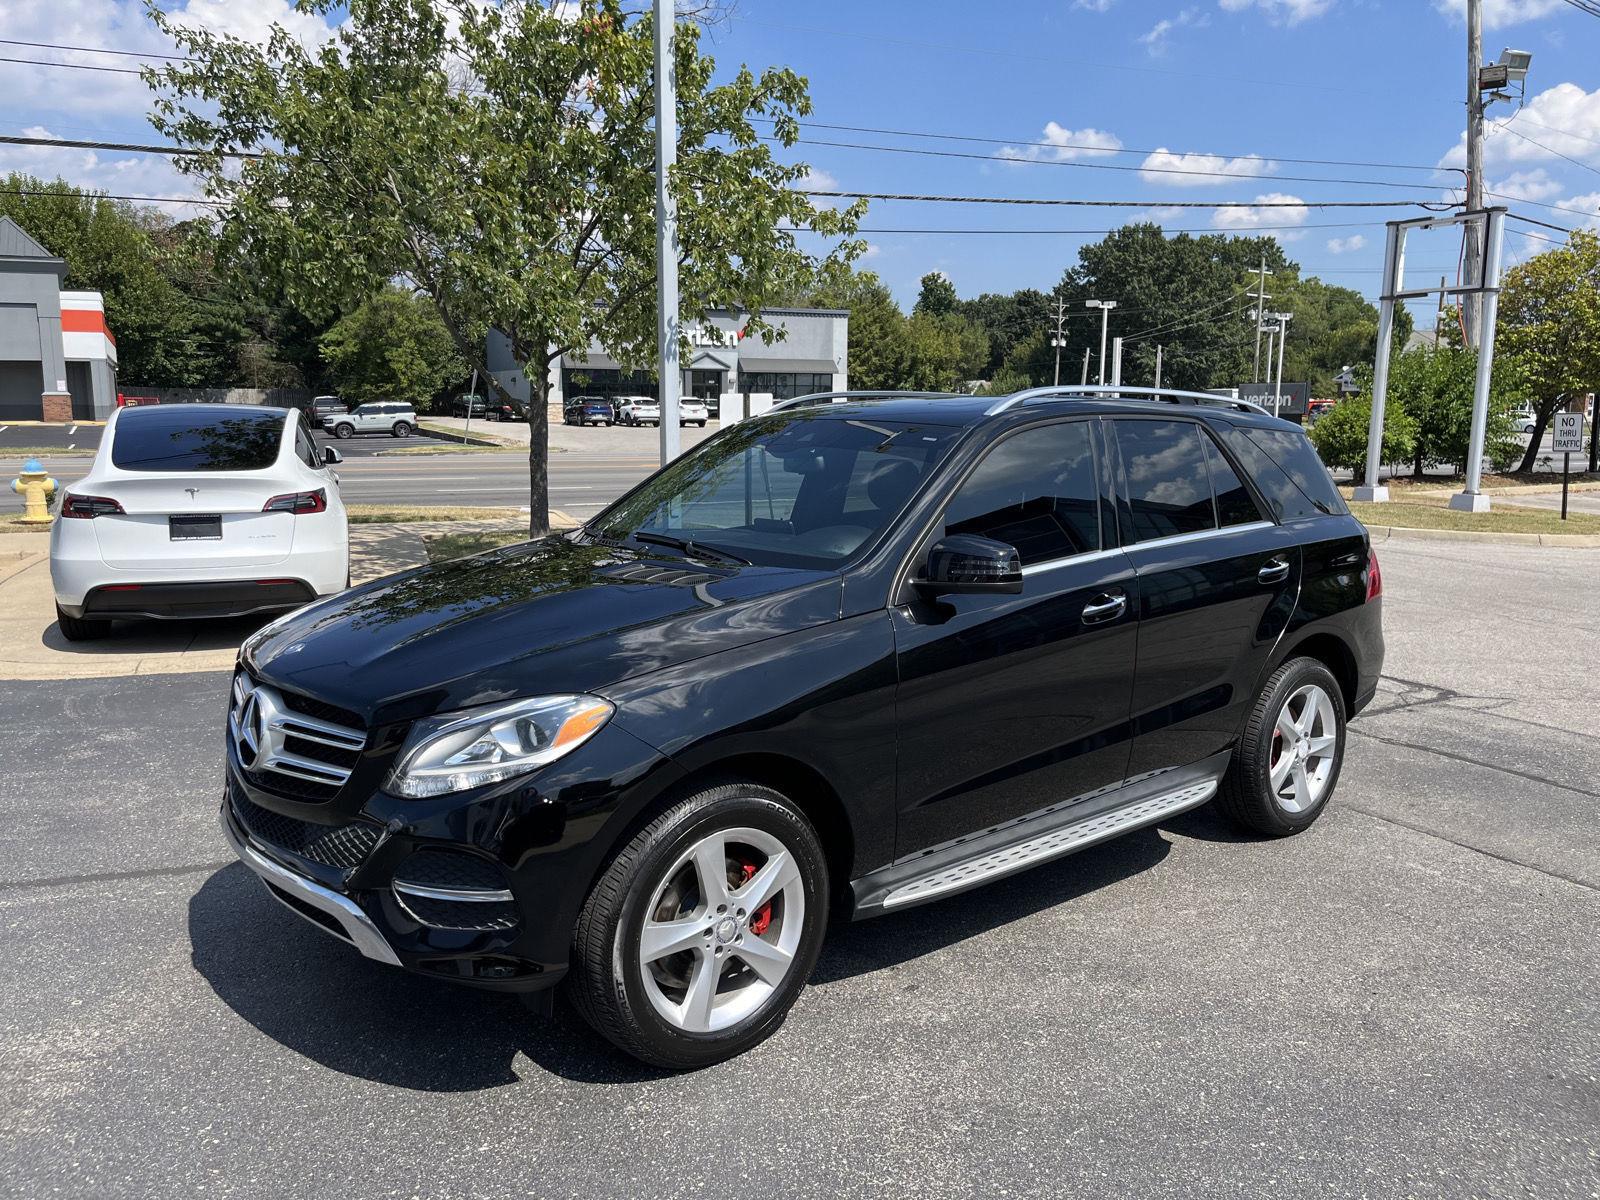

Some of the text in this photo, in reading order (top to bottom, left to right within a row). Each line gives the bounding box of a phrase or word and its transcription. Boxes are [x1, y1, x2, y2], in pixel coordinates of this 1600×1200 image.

[681, 324, 738, 346] rizon
[1561, 417, 1575, 427] NO
[1560, 429, 1577, 437] THRU
[1555, 439, 1580, 448] TRAFFIC
